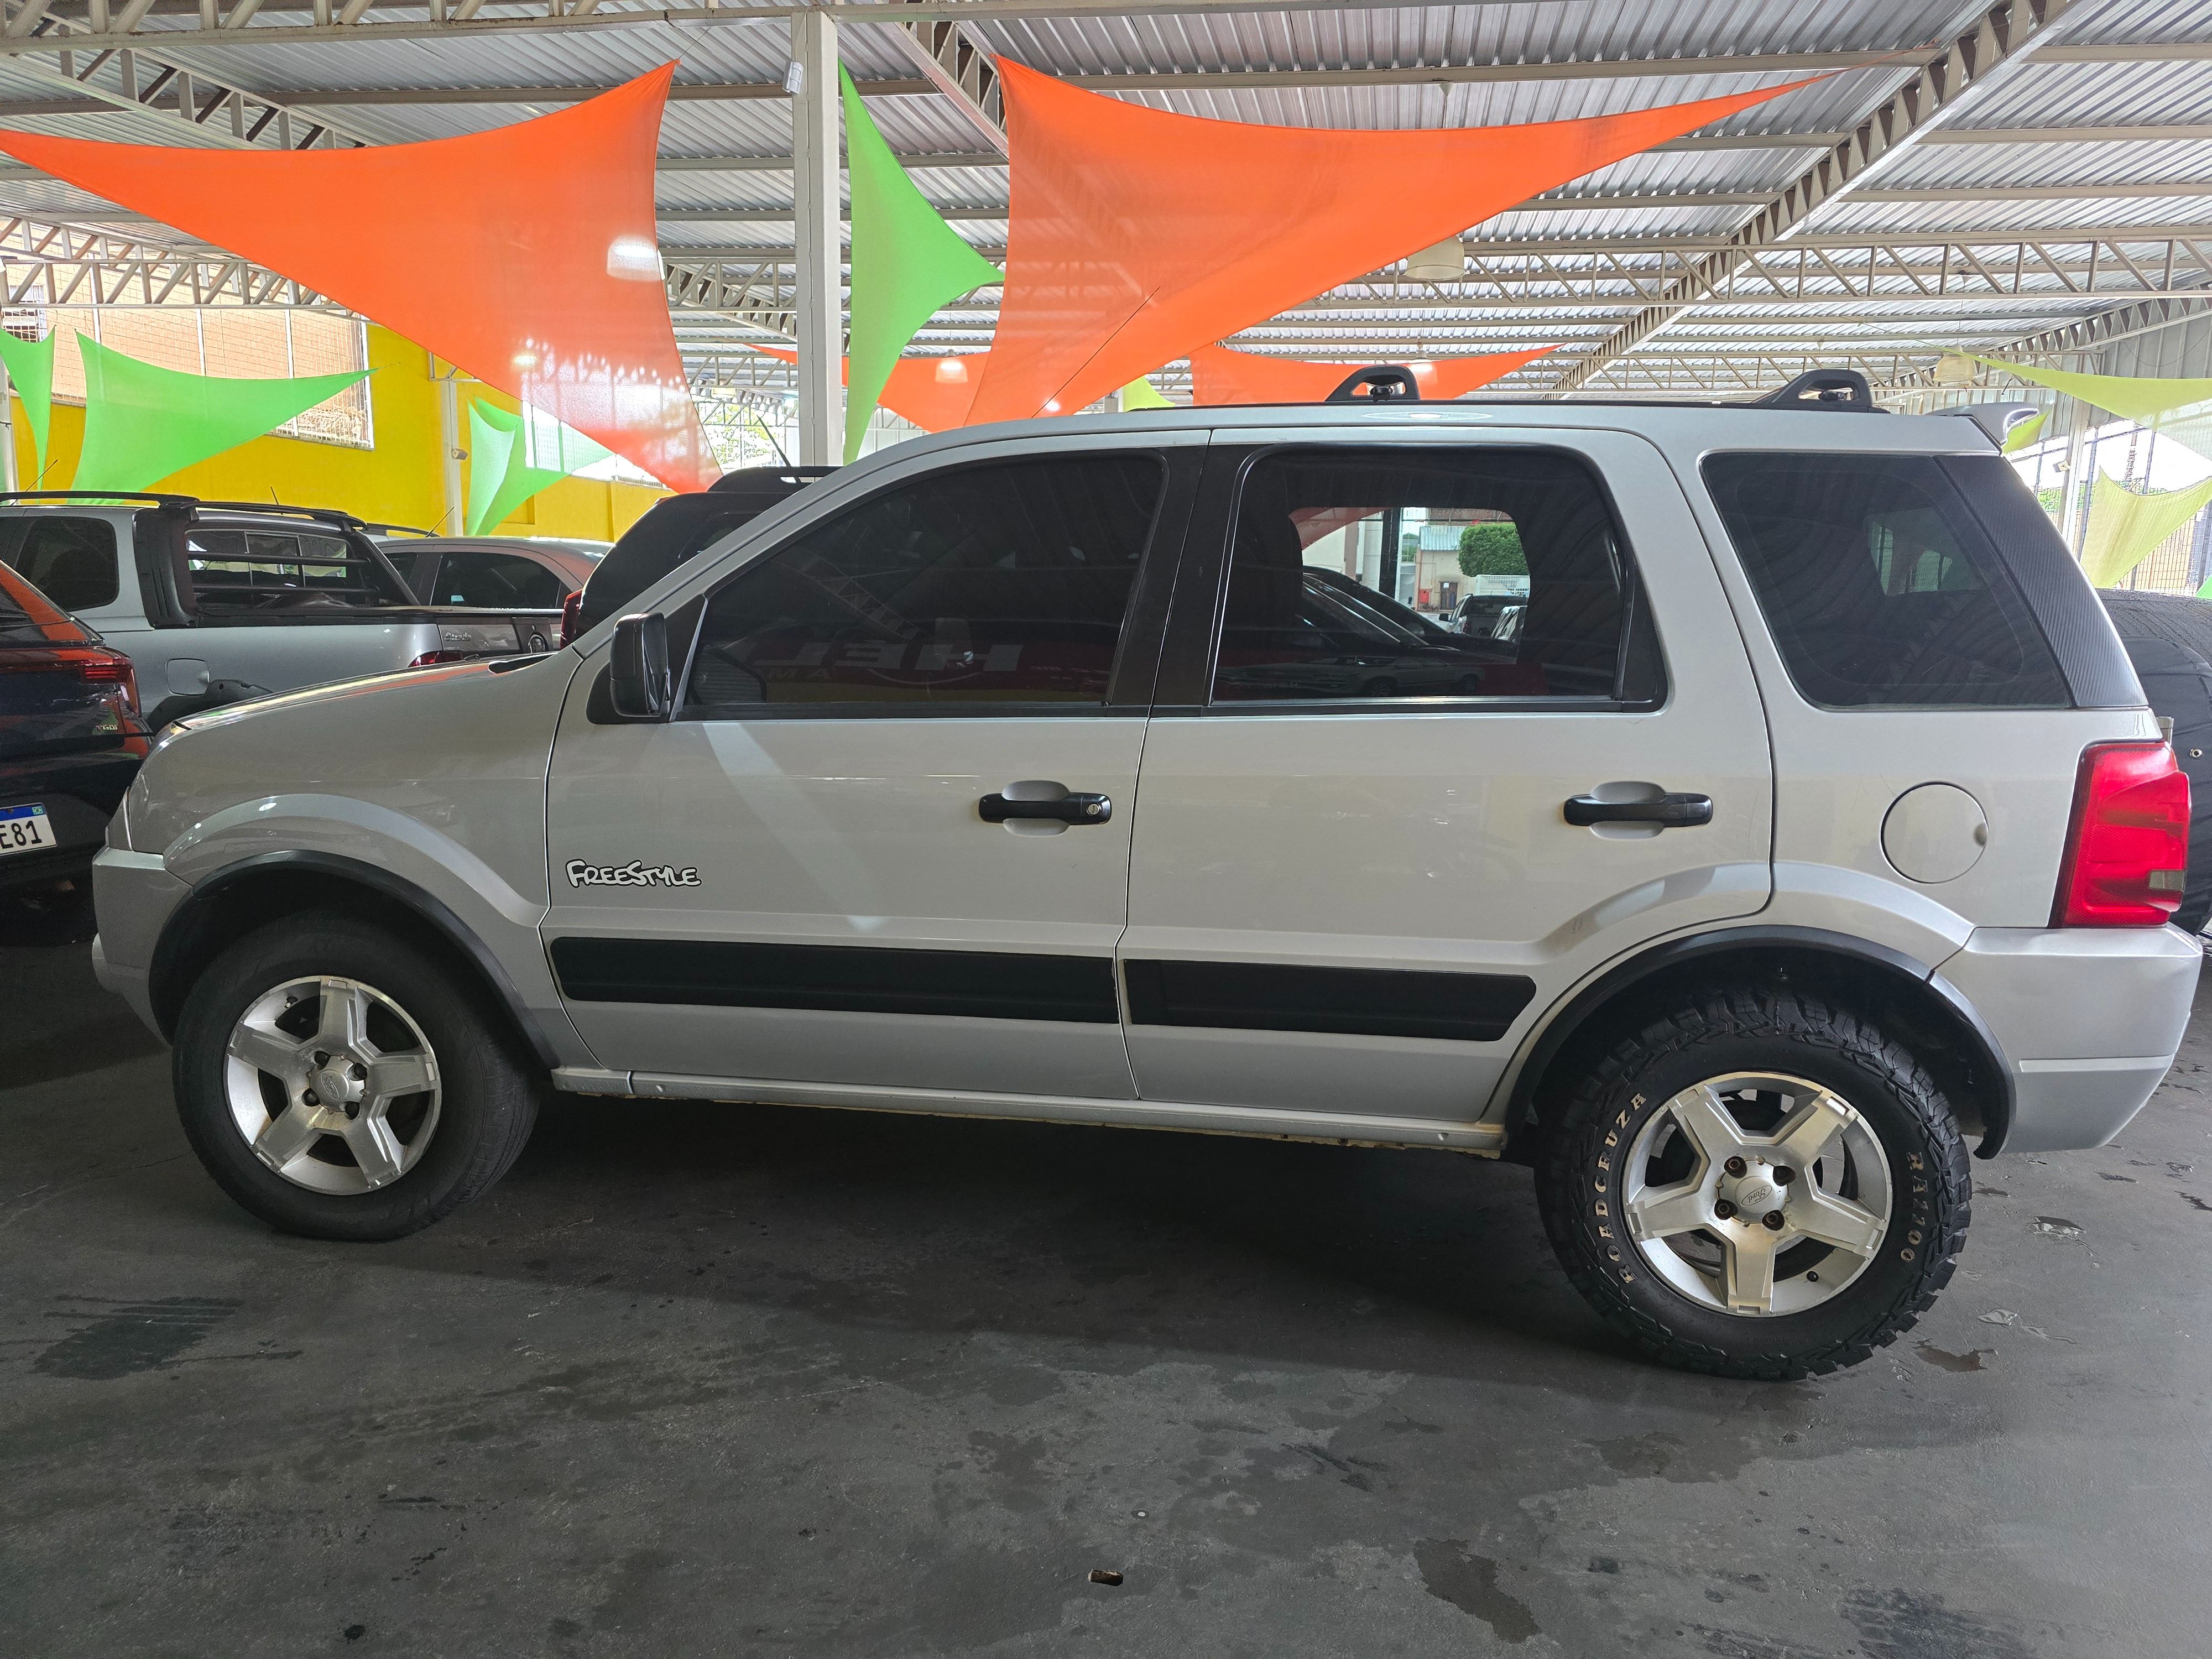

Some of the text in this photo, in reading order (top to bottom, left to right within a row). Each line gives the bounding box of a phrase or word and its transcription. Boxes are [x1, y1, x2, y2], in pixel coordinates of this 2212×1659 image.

[0, 820, 43, 849] E81
[1594, 1092, 1647, 1285] ROADCRUZA
[1747, 1188, 1766, 1203] Ford
